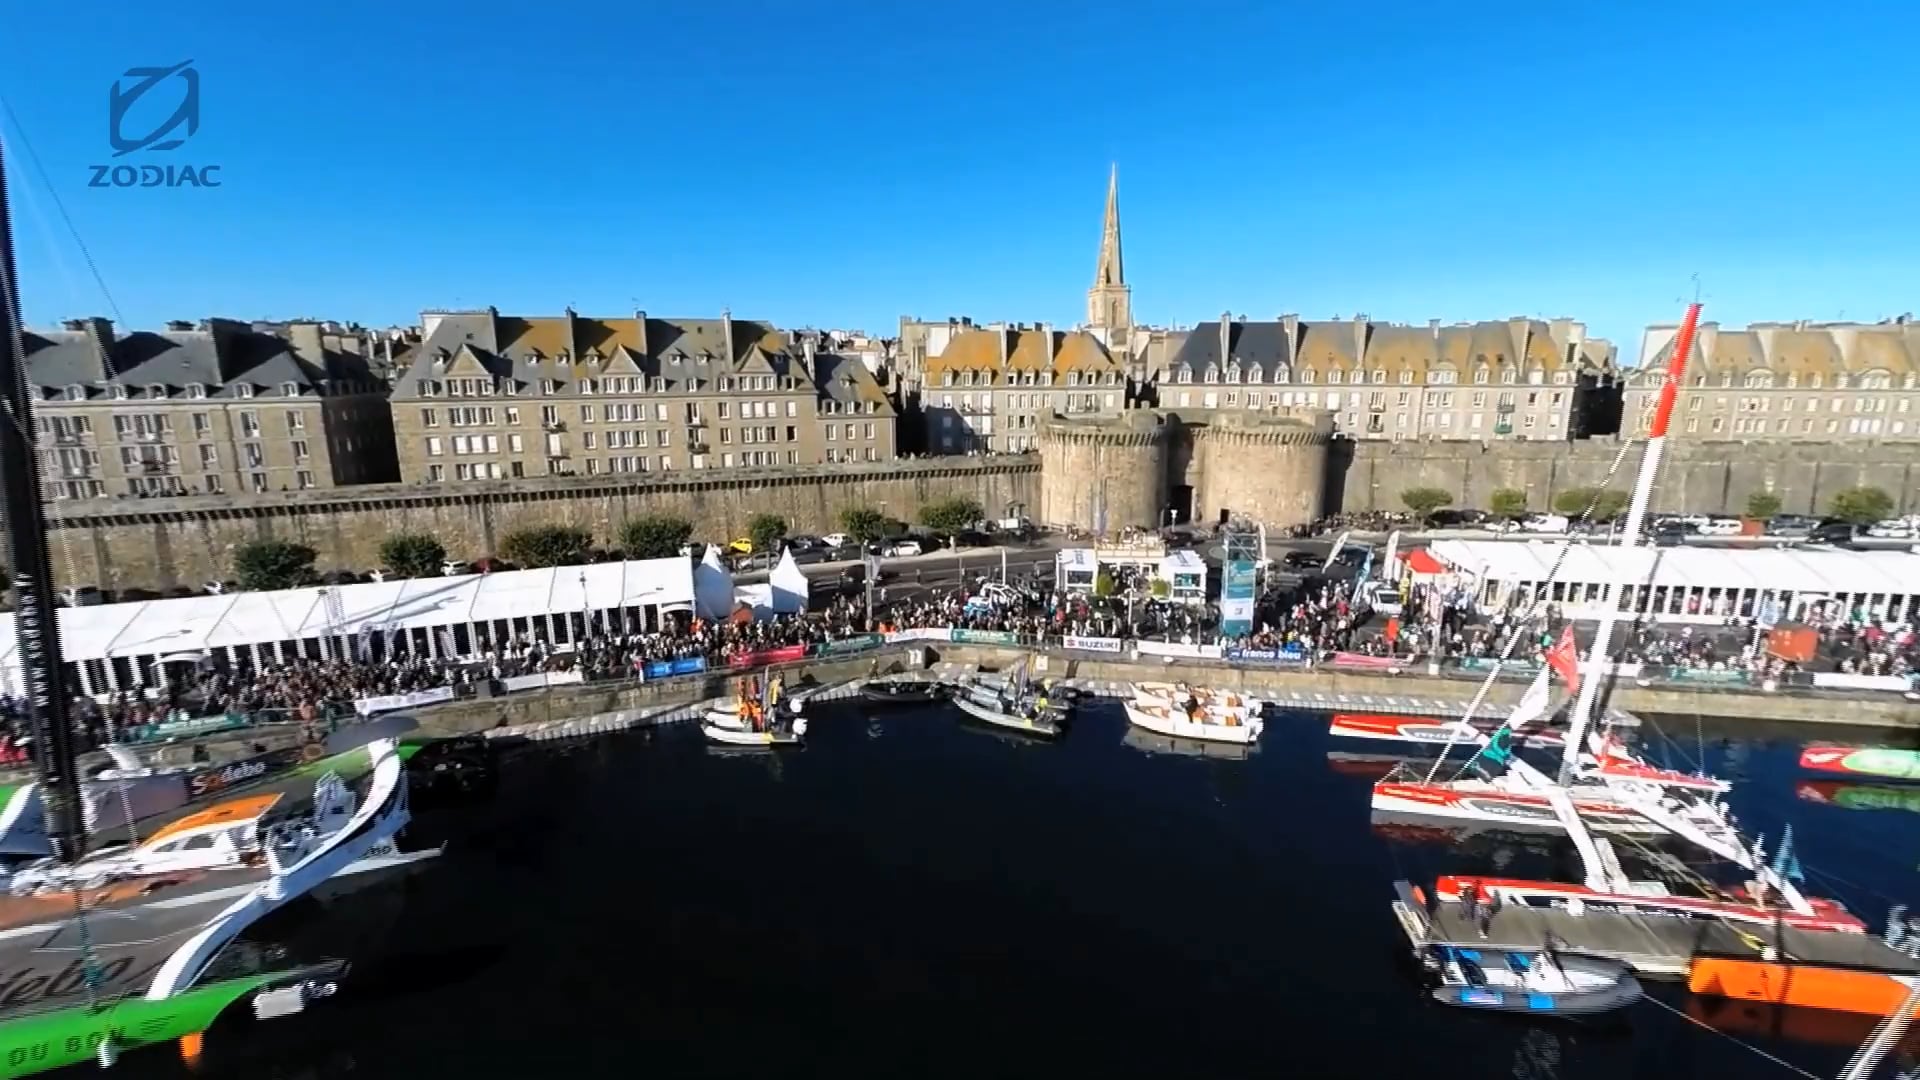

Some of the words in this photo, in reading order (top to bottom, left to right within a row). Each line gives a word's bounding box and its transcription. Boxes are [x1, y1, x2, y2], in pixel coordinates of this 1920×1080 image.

[1078, 640, 1118, 649] SUZUKI
[191, 761, 266, 795] Sodebo
[8, 1042, 49, 1067] DU
